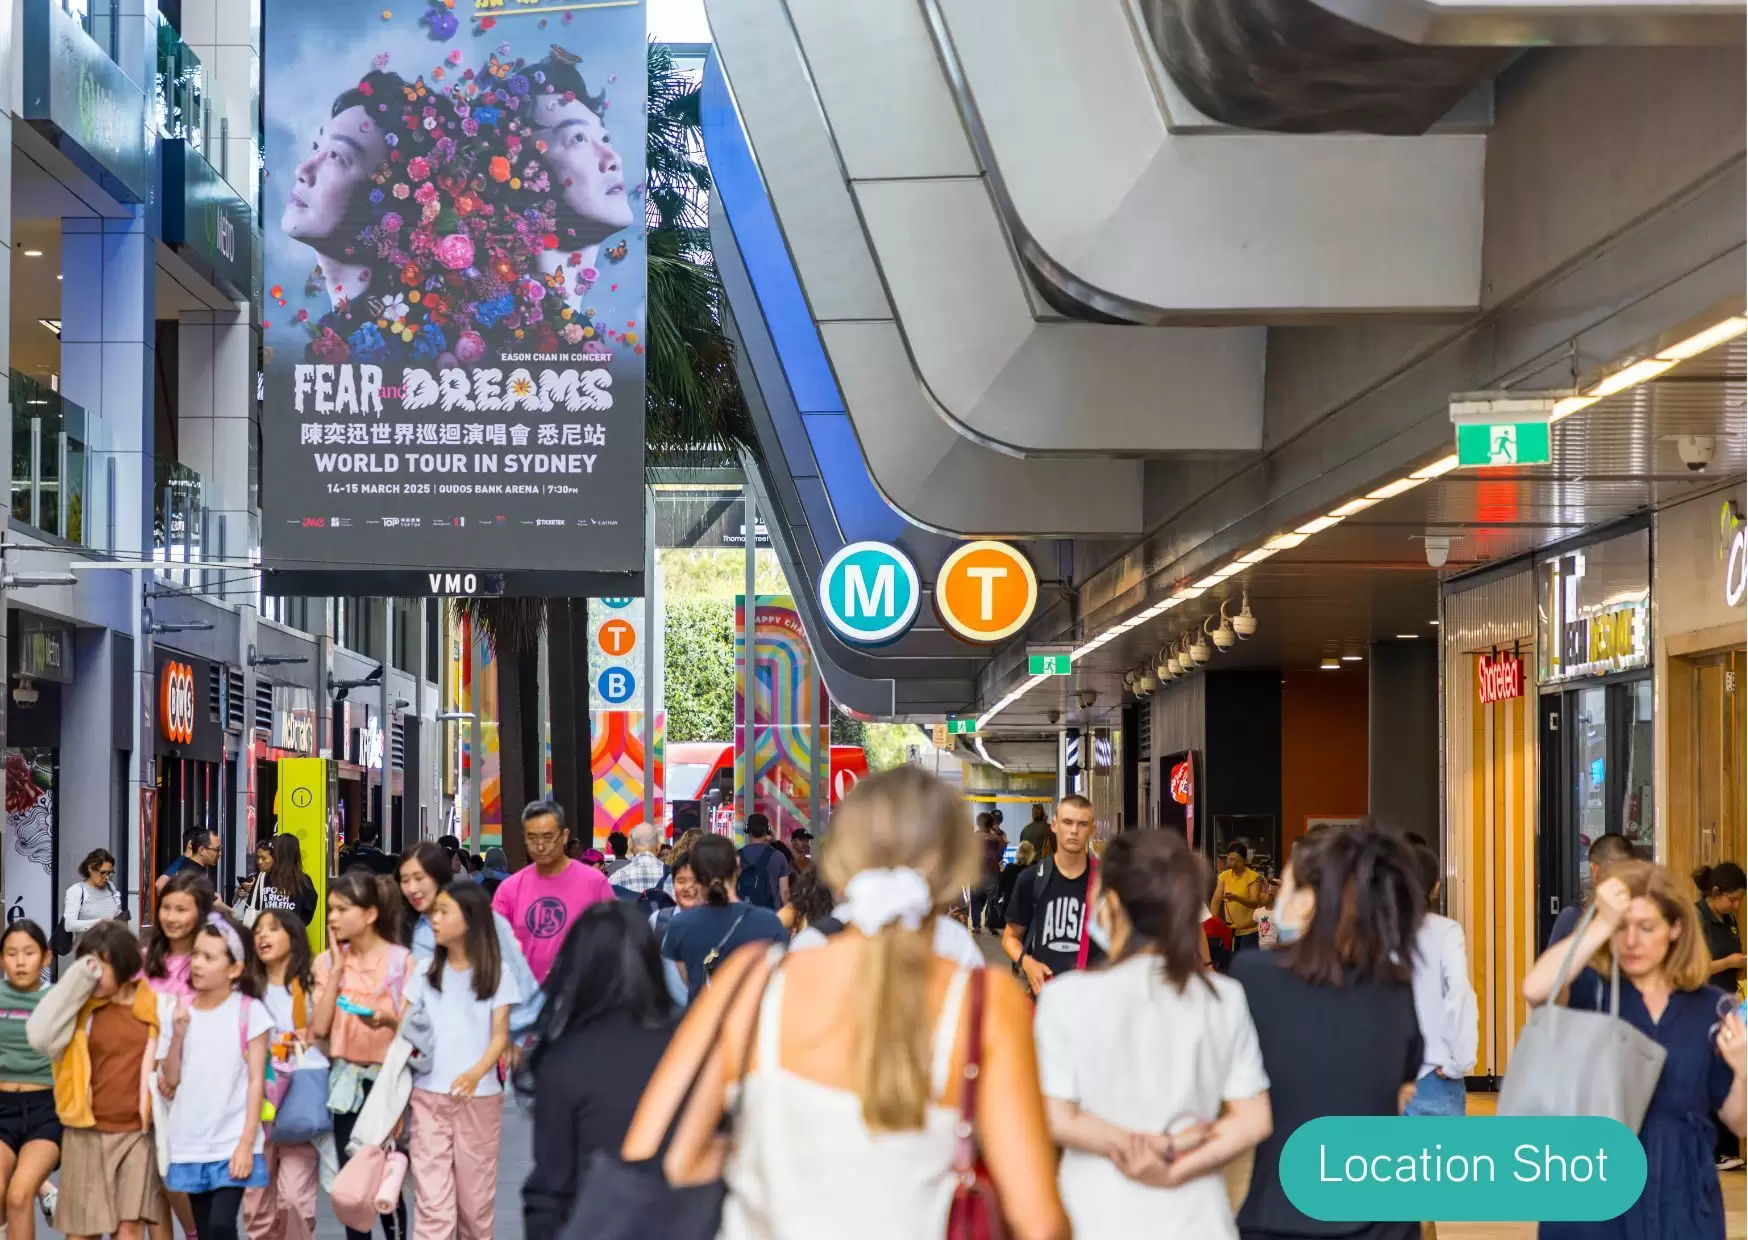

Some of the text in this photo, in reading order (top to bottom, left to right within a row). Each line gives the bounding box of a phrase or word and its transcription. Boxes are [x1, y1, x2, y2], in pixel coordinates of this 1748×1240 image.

[501, 353, 613, 362] EASON CHAN IN CONCERT
[294, 364, 614, 418] FEAR and DREAMS
[301, 423, 606, 446] 陳奕迅世界巡迴演唱會 悉尼站
[314, 453, 598, 473] WORLD TOUR IN SYDNEY
[327, 483, 358, 494] 14-15
[361, 483, 400, 494] MARCH
[403, 483, 430, 494] 2025
[439, 484, 472, 494] QUDOS
[475, 484, 502, 494] BANK
[505, 484, 539, 494] ARENA
[429, 573, 477, 593] VMO
[845, 564, 895, 617] M
[967, 567, 1008, 621] T
[755, 615, 781, 624] APPY
[608, 626, 627, 651] T
[608, 673, 627, 698] B
[268, 893, 290, 902] RICH
